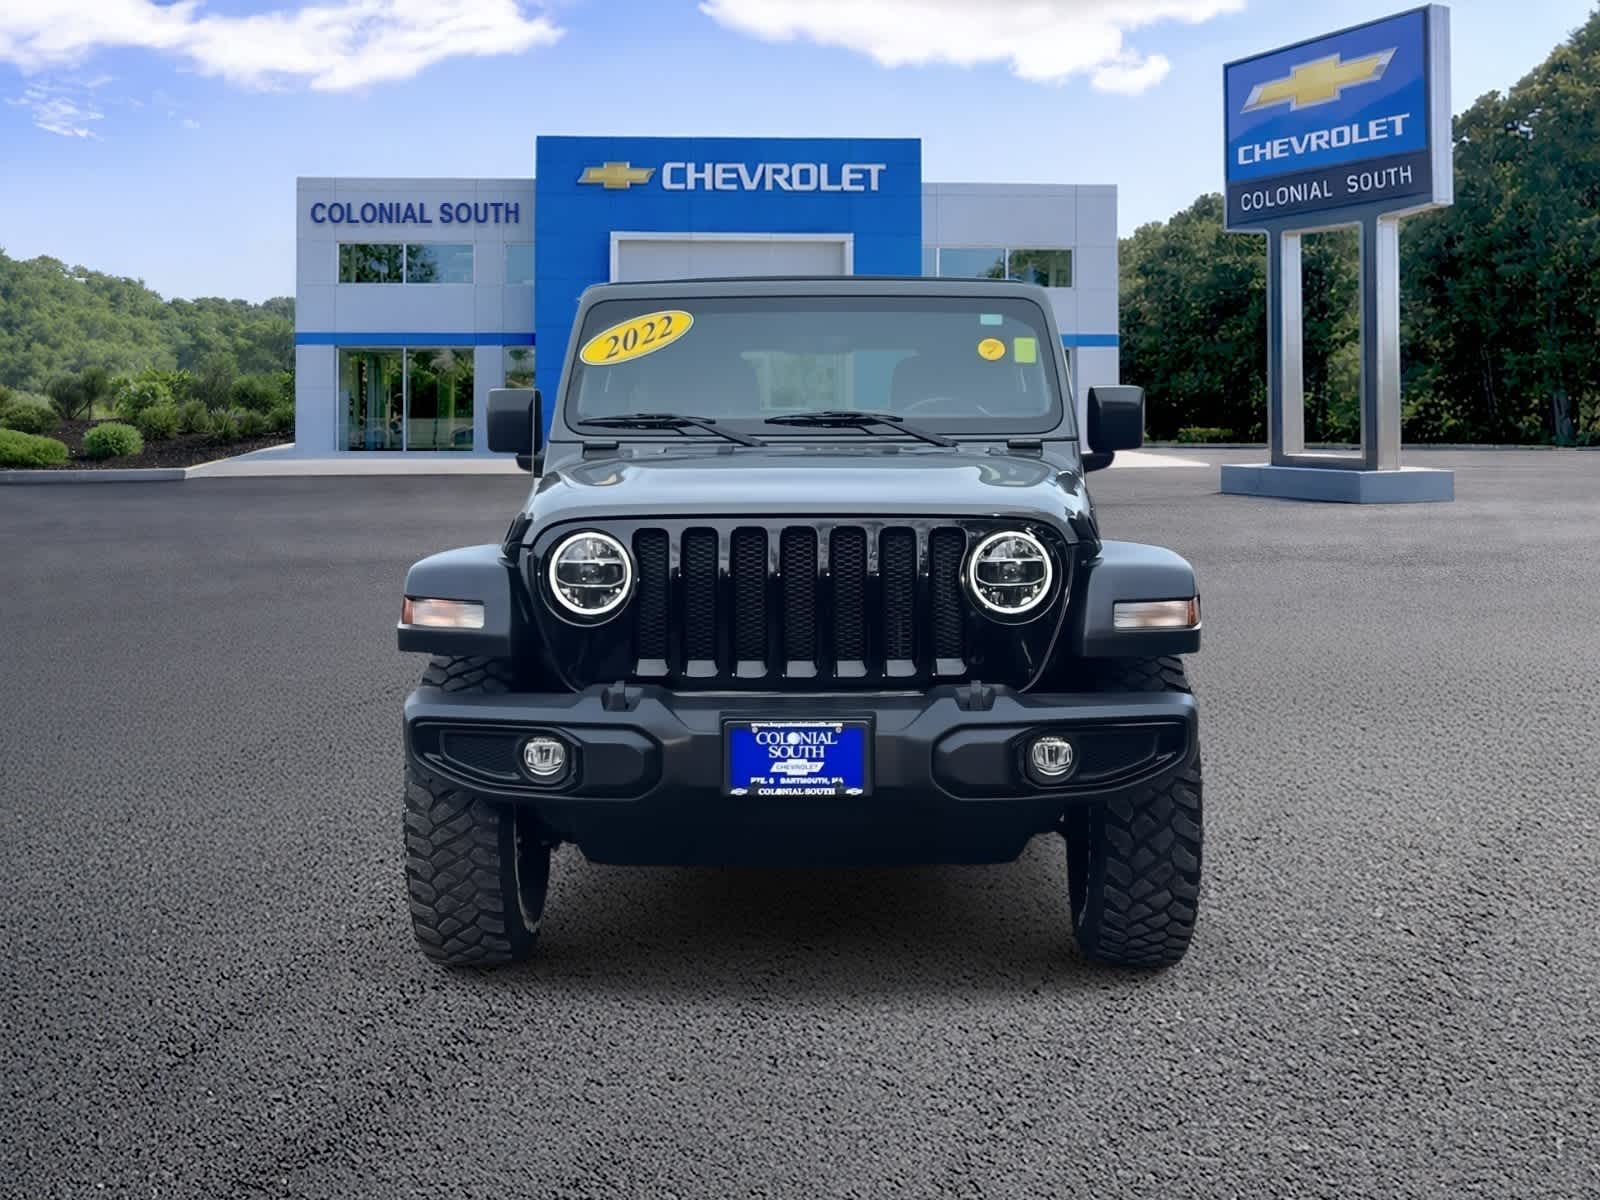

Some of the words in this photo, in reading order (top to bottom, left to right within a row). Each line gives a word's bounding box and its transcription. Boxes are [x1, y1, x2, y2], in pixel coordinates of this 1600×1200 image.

[1237, 113, 1410, 165] CHEVROLET
[662, 161, 887, 192] CHEVROLET
[1240, 180, 1333, 212] COLONIAL
[1346, 165, 1413, 194] SOUTH
[310, 202, 433, 225] COLONIAL
[439, 202, 520, 225] SOUTH
[605, 315, 673, 359] 2022
[756, 732, 838, 745] COLONIAL
[768, 745, 825, 758] SOUTH
[758, 788, 804, 796] COLONIAL
[804, 788, 836, 796] SOUTH
